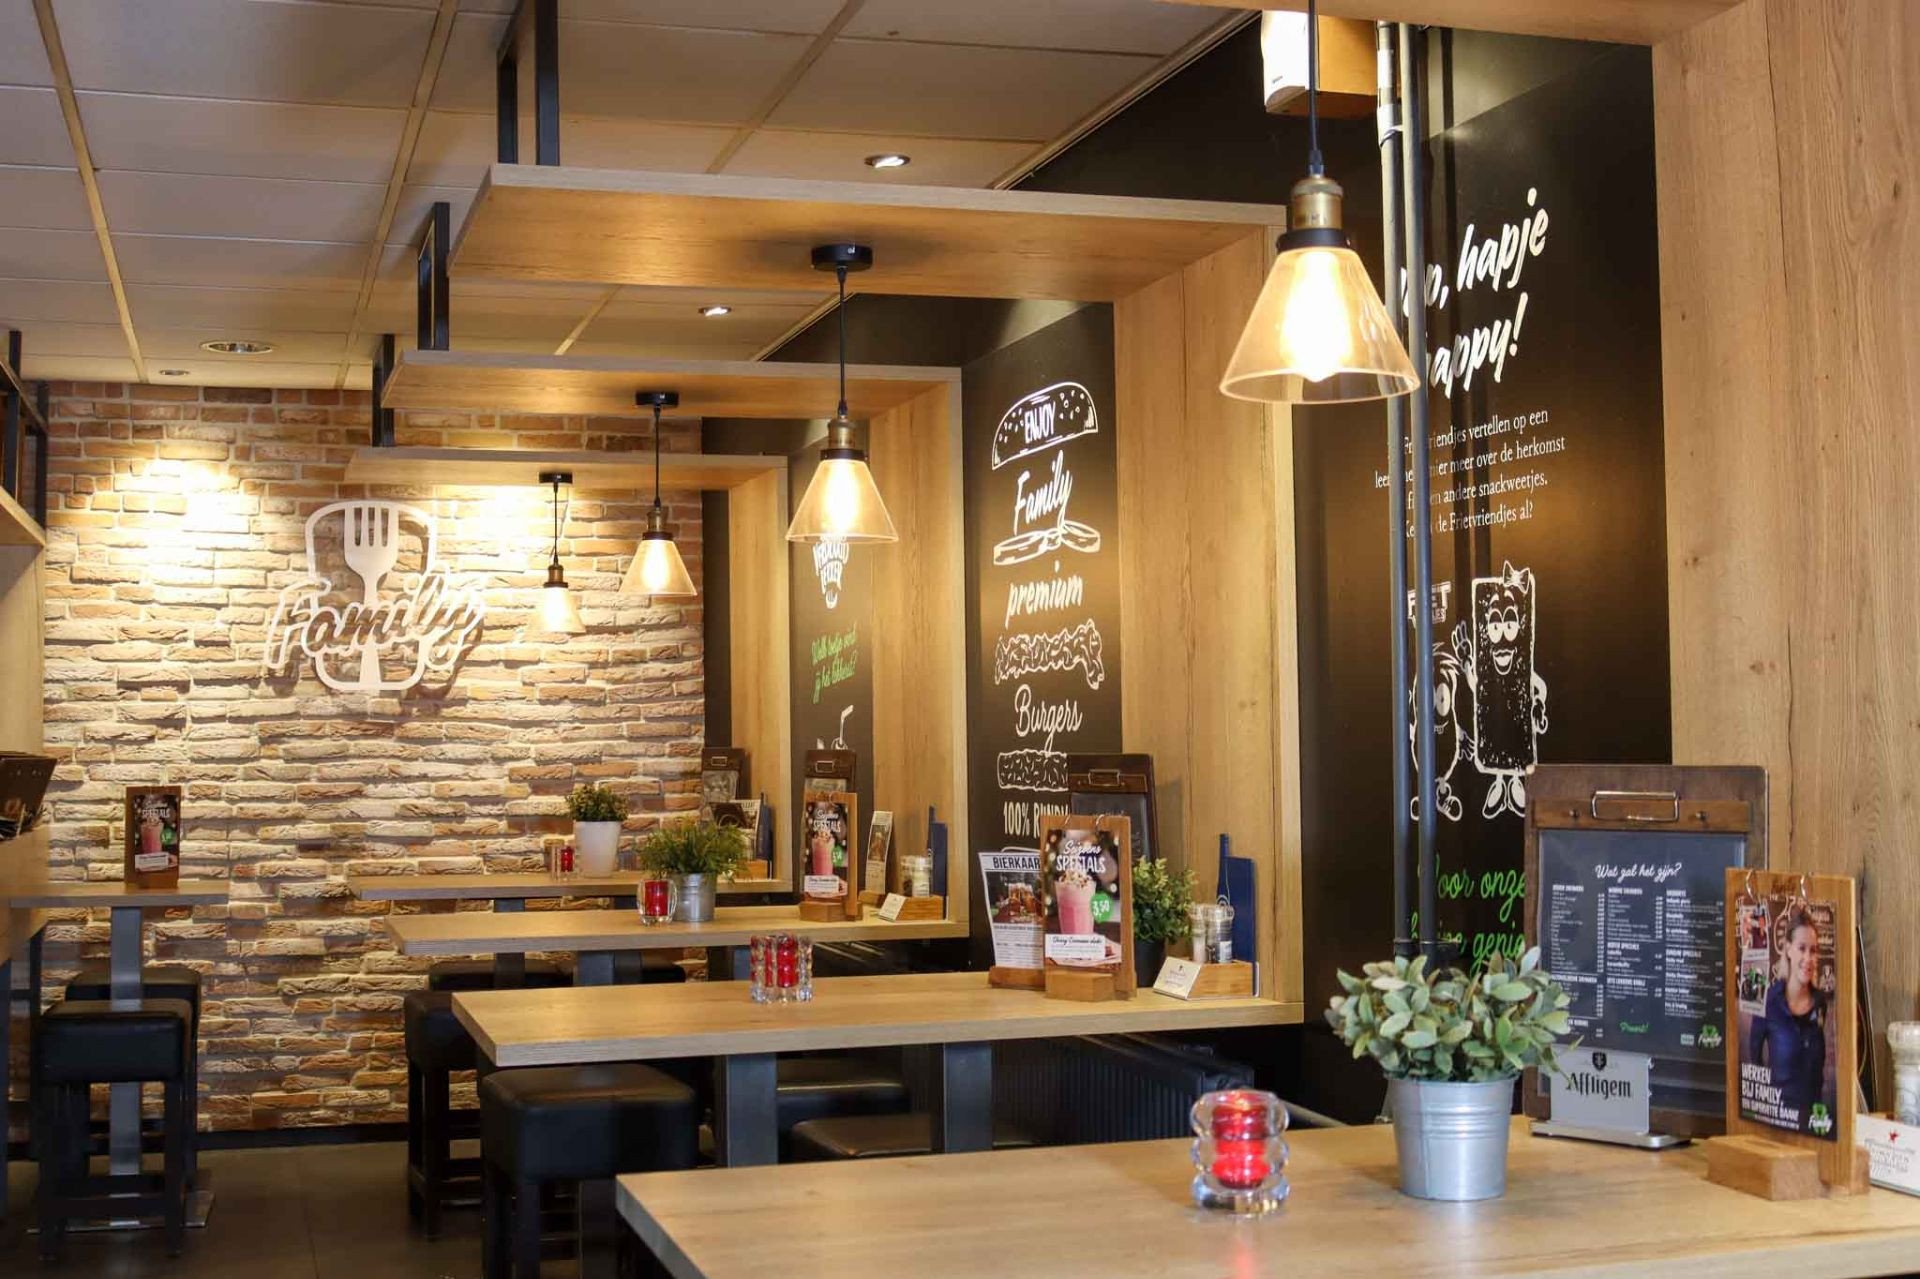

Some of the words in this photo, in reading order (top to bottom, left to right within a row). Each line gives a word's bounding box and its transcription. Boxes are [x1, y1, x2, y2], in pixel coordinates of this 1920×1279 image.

[1457, 187, 1549, 292] hapje
[1426, 292, 1528, 399] appy!
[1468, 415, 1511, 439] vertellen
[1513, 416, 1527, 434] op
[1529, 410, 1549, 426] een
[1450, 457, 1475, 473] meer
[1477, 453, 1498, 468] over
[1500, 444, 1513, 462] de
[1516, 436, 1566, 459] herkomst
[1014, 450, 1073, 535] Family
[1443, 481, 1477, 504] andere
[1478, 469, 1548, 497] snackweetjes.
[1449, 503, 1517, 530] Frietvriendjes
[1519, 498, 1533, 521] al?
[1005, 560, 1083, 629] premium
[263, 563, 485, 671] Family
[1015, 684, 1083, 748] Burgers
[1003, 801, 1030, 836] 100%
[1417, 853, 1475, 898] oor
[1481, 870, 1525, 922] onze
[1594, 864, 1618, 878] Wat
[1617, 864, 1638, 883] zal
[1638, 864, 1654, 878] het
[1654, 862, 1682, 883] zijn?
[1565, 1072, 1631, 1099] Affligem
[1741, 1063, 1771, 1085] WERKEN
